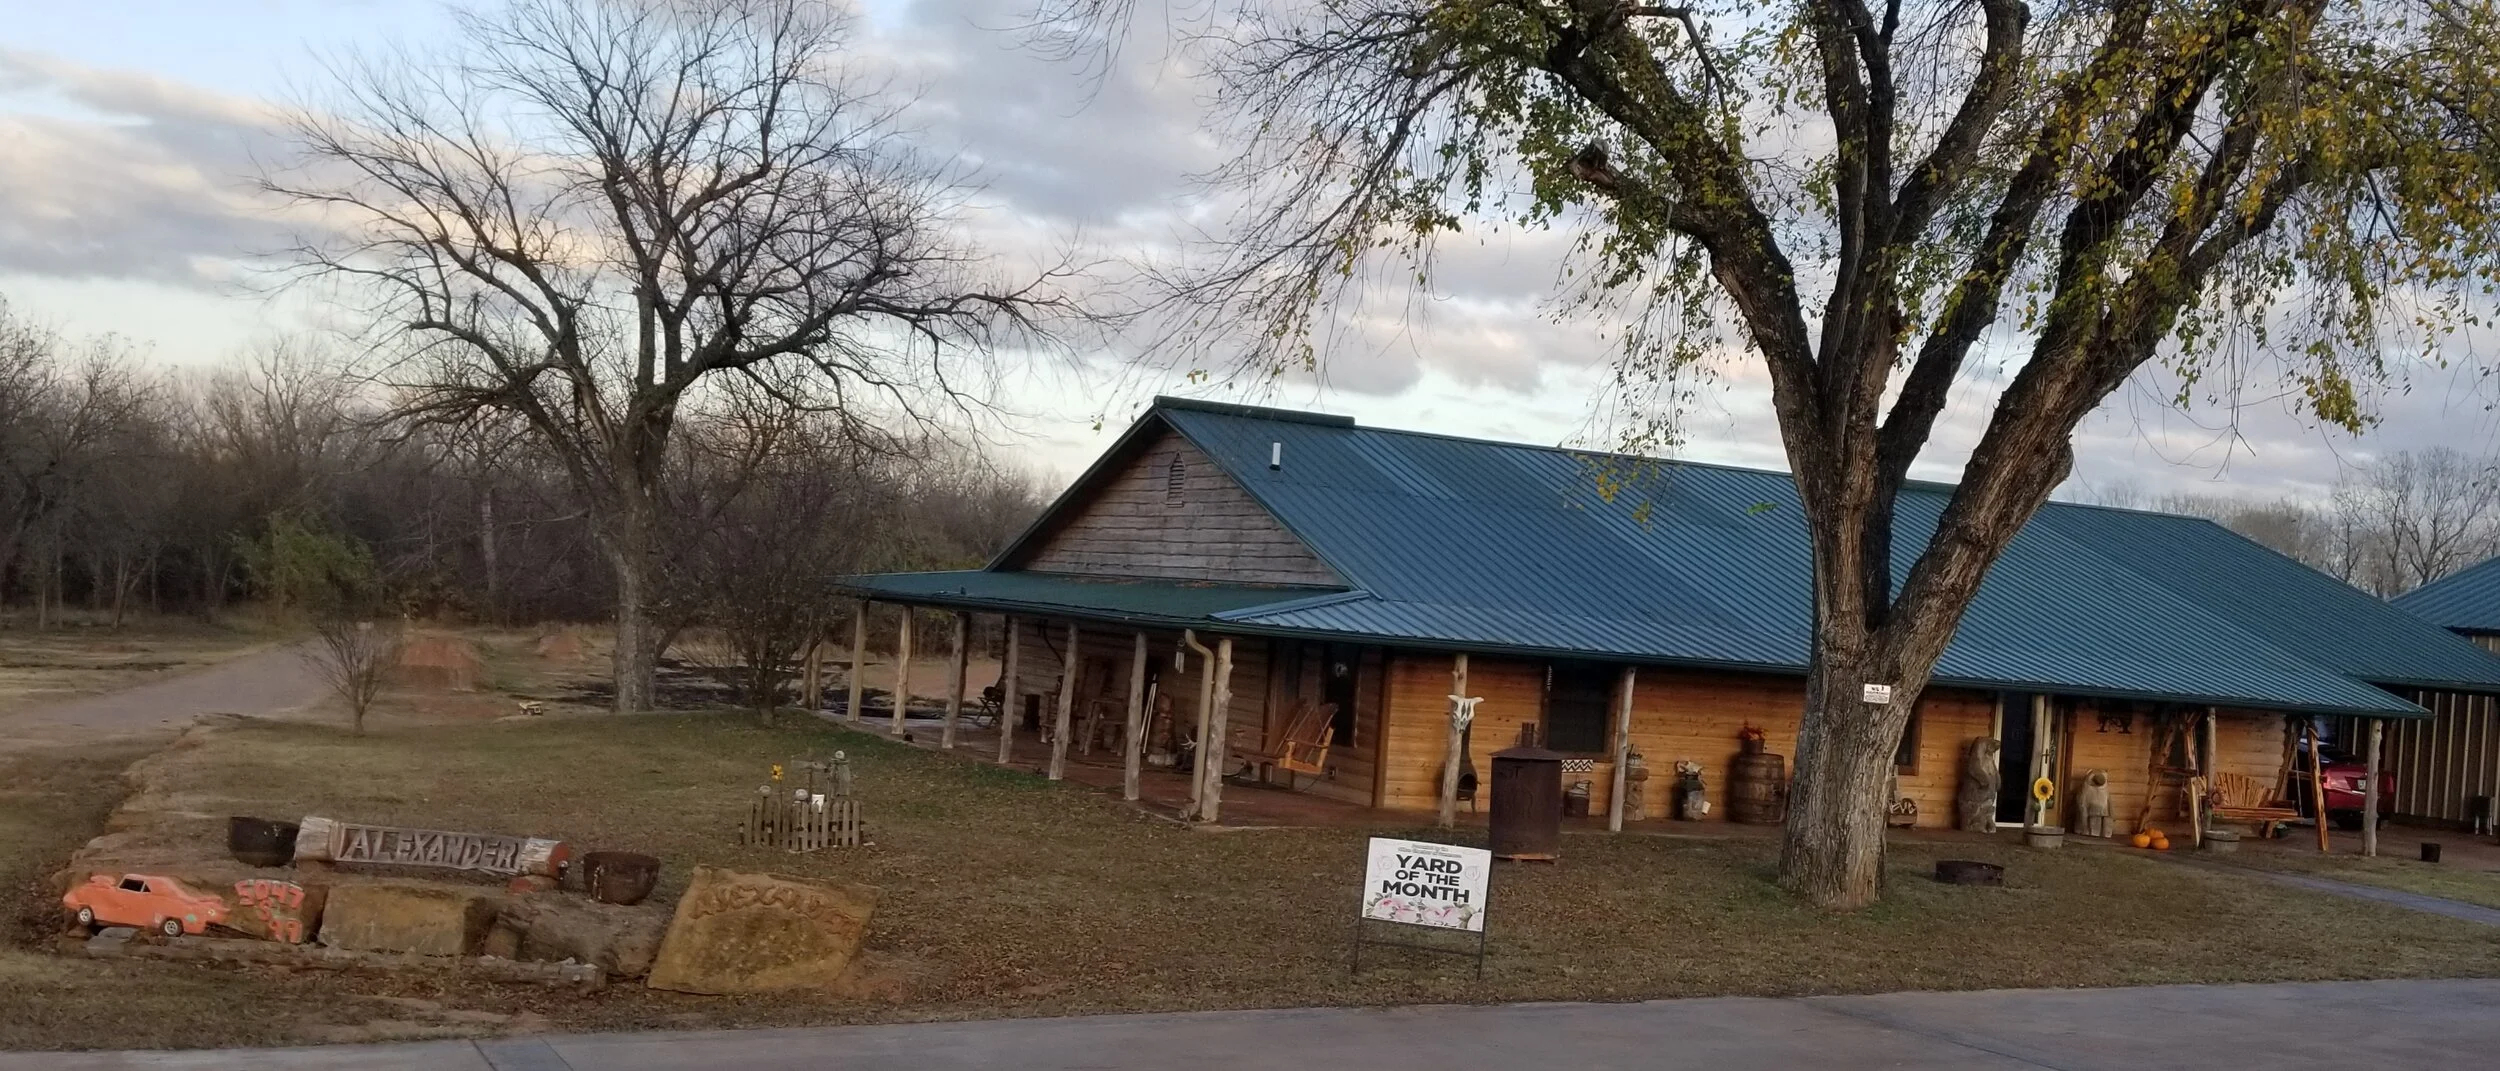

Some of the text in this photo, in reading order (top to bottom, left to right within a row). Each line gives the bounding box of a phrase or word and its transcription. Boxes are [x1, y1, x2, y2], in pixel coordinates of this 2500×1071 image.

[347, 829, 520, 870] ALEXANDER
[1396, 854, 1462, 874] YARD
[1395, 870, 1460, 886] OF THE
[1382, 880, 1470, 902] MONTH
